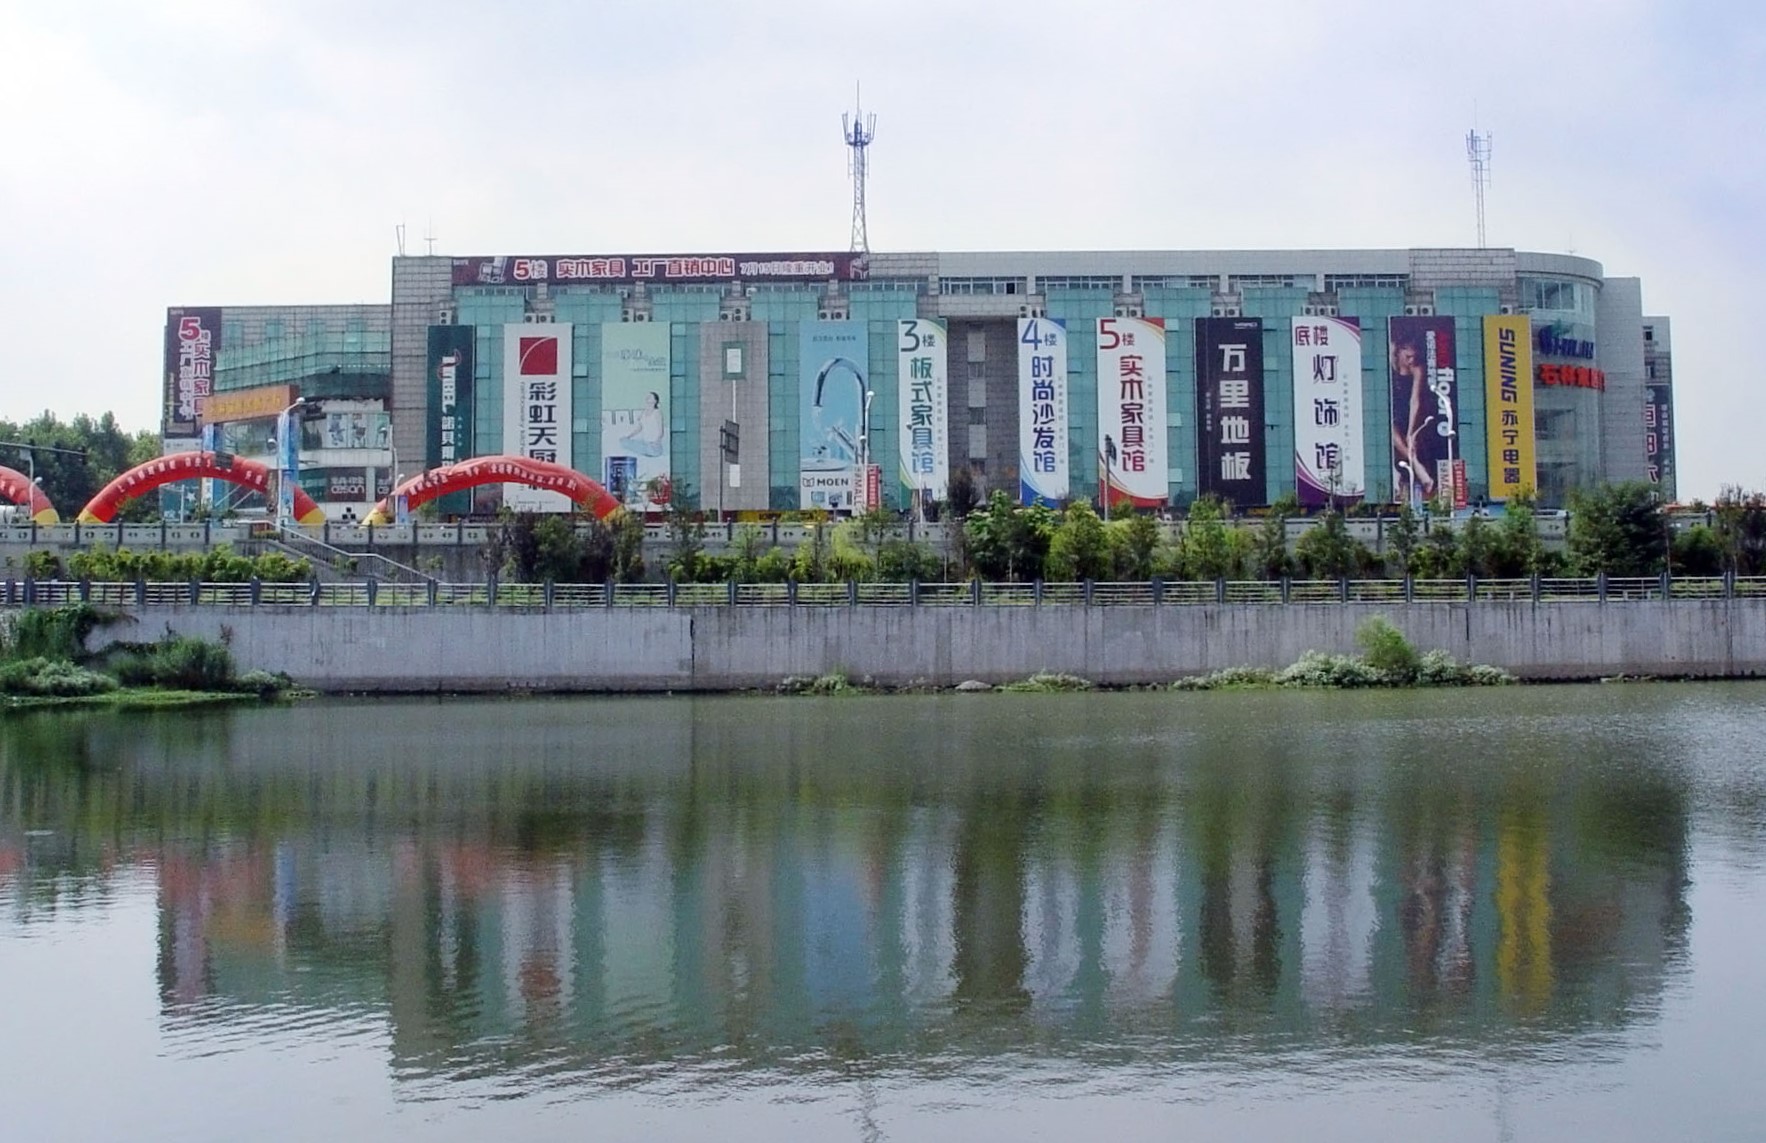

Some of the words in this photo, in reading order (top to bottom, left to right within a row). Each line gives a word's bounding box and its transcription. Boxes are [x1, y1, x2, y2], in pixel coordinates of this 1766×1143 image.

[513, 258, 548, 280] 5楼
[556, 258, 626, 278] 实木家具
[631, 256, 736, 277] 工厂直销中心
[900, 320, 936, 352] 3楼
[1021, 319, 1058, 351] 4楼
[1099, 319, 1135, 350] 5楼
[1295, 326, 1329, 347] 底楼
[1499, 328, 1517, 404] SUNING
[911, 357, 934, 475] 板式家具馆
[1031, 356, 1056, 473] 时尚沙发馆
[1119, 355, 1146, 473] 实木家具馆
[1218, 343, 1252, 480] 万里地板
[1313, 354, 1341, 470] 灯饰馆
[1502, 410, 1521, 484] 苏宁电器
[817, 478, 849, 487] MOEN
